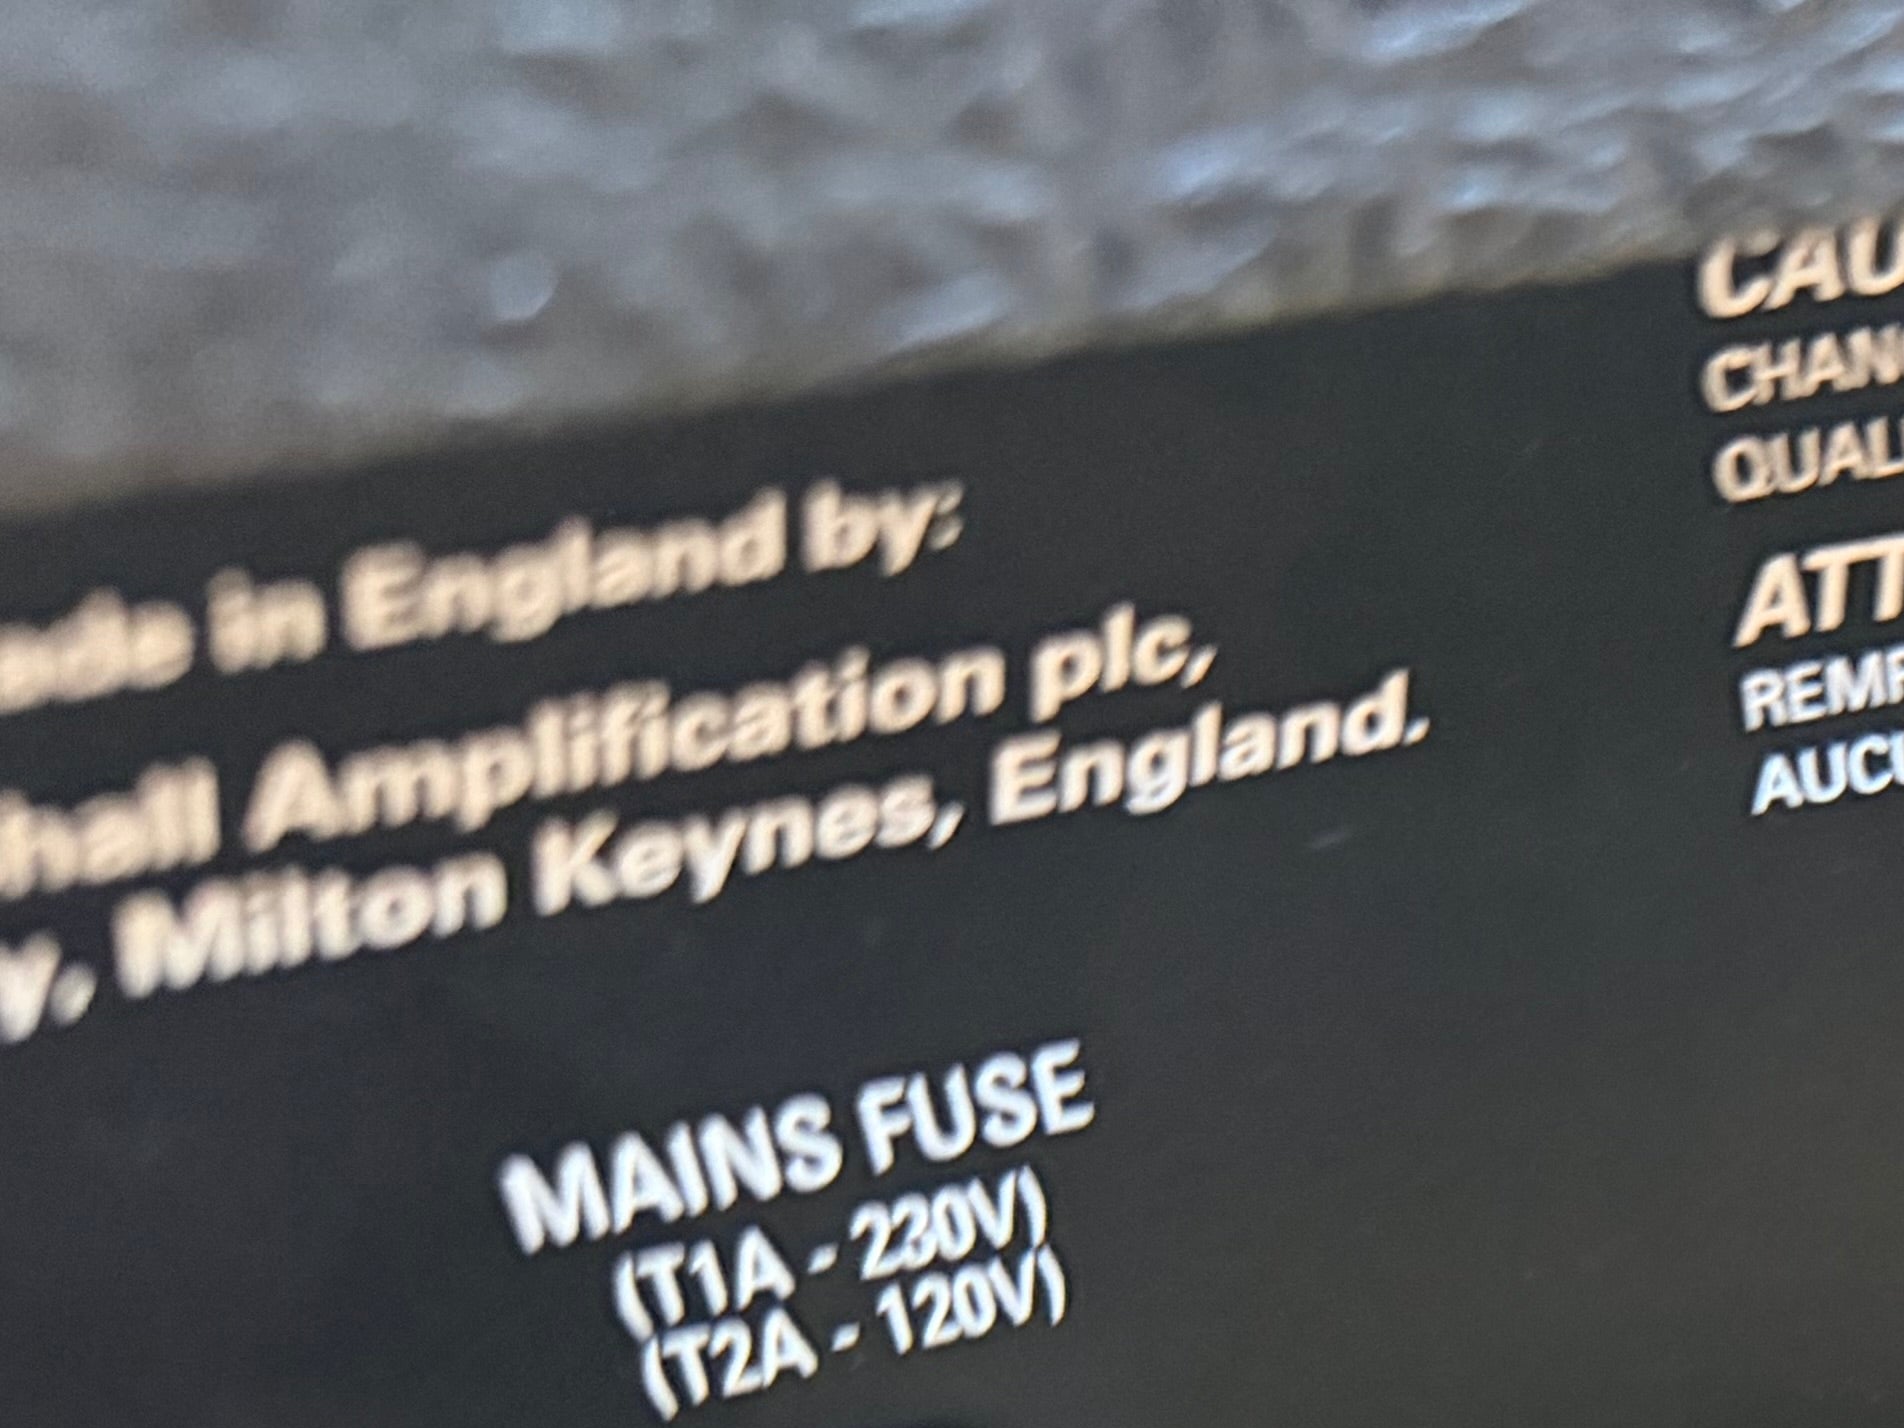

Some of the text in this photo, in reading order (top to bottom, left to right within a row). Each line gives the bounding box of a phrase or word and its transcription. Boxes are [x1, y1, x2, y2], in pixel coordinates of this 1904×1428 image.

[0, 484, 961, 712] ade in England by:
[0, 605, 1215, 897] hall Amplification plc,
[115, 855, 507, 997] Milton
[534, 777, 963, 915] Keynes,
[990, 670, 1429, 825] England.
[501, 1041, 1095, 1253] MAINS FUSE
[614, 1226, 796, 1342] (T1A
[849, 1165, 1047, 1280] 230V)
[642, 1308, 818, 1420] (T2A
[876, 1237, 1066, 1354] 120V)
